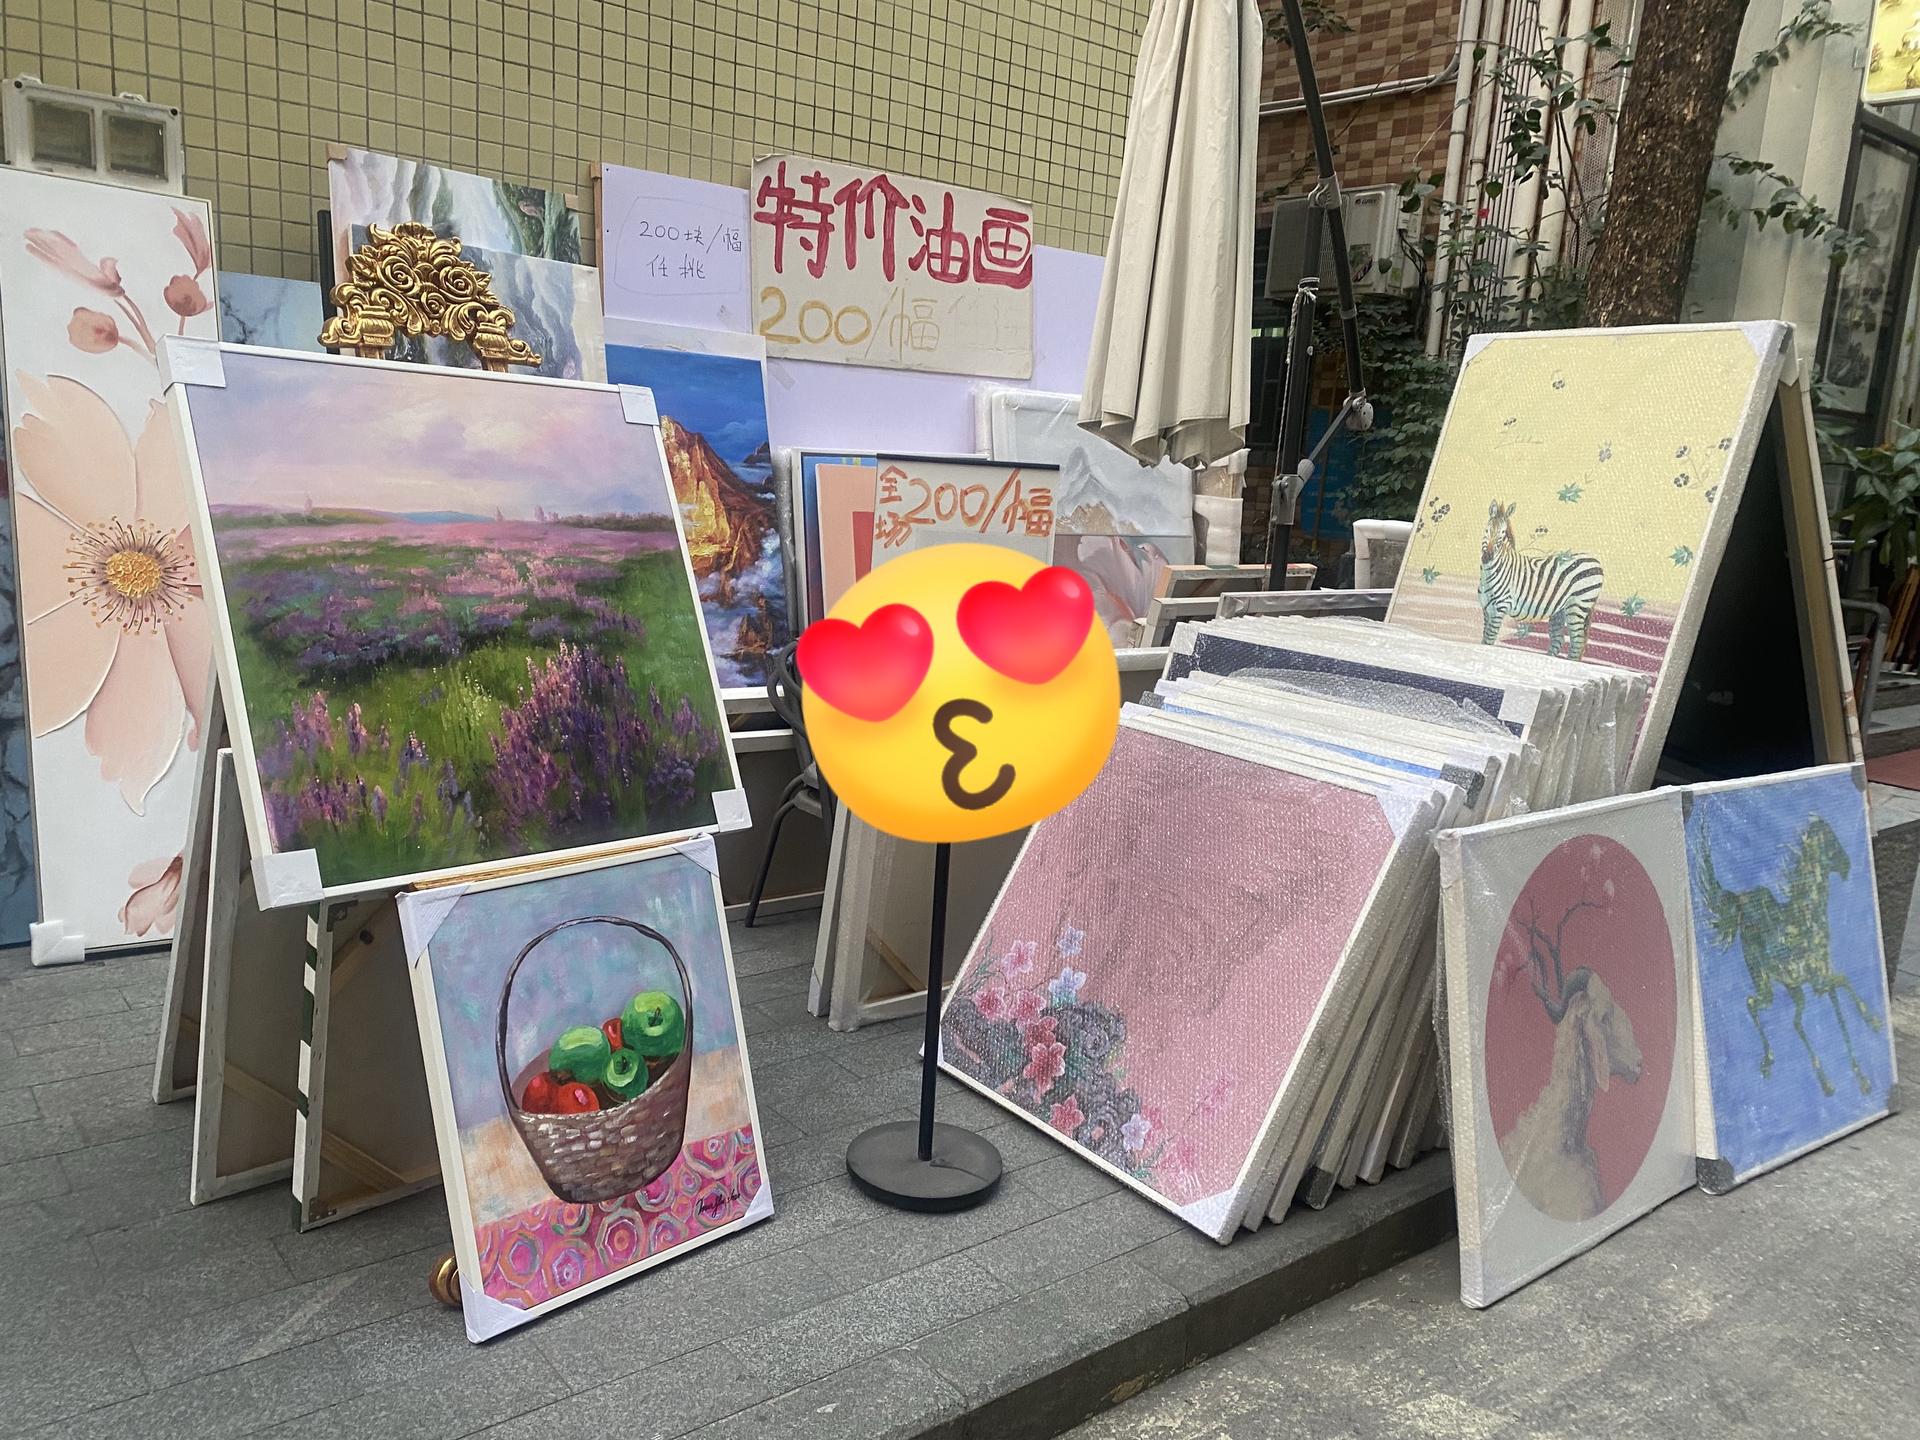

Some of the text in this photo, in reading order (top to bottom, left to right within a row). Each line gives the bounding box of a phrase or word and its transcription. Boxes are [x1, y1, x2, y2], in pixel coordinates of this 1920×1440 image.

[639, 220, 742, 254] 200块/幅
[753, 160, 1033, 289] 特价油画
[646, 253, 706, 279] 任挑
[759, 286, 941, 362] 200/幅
